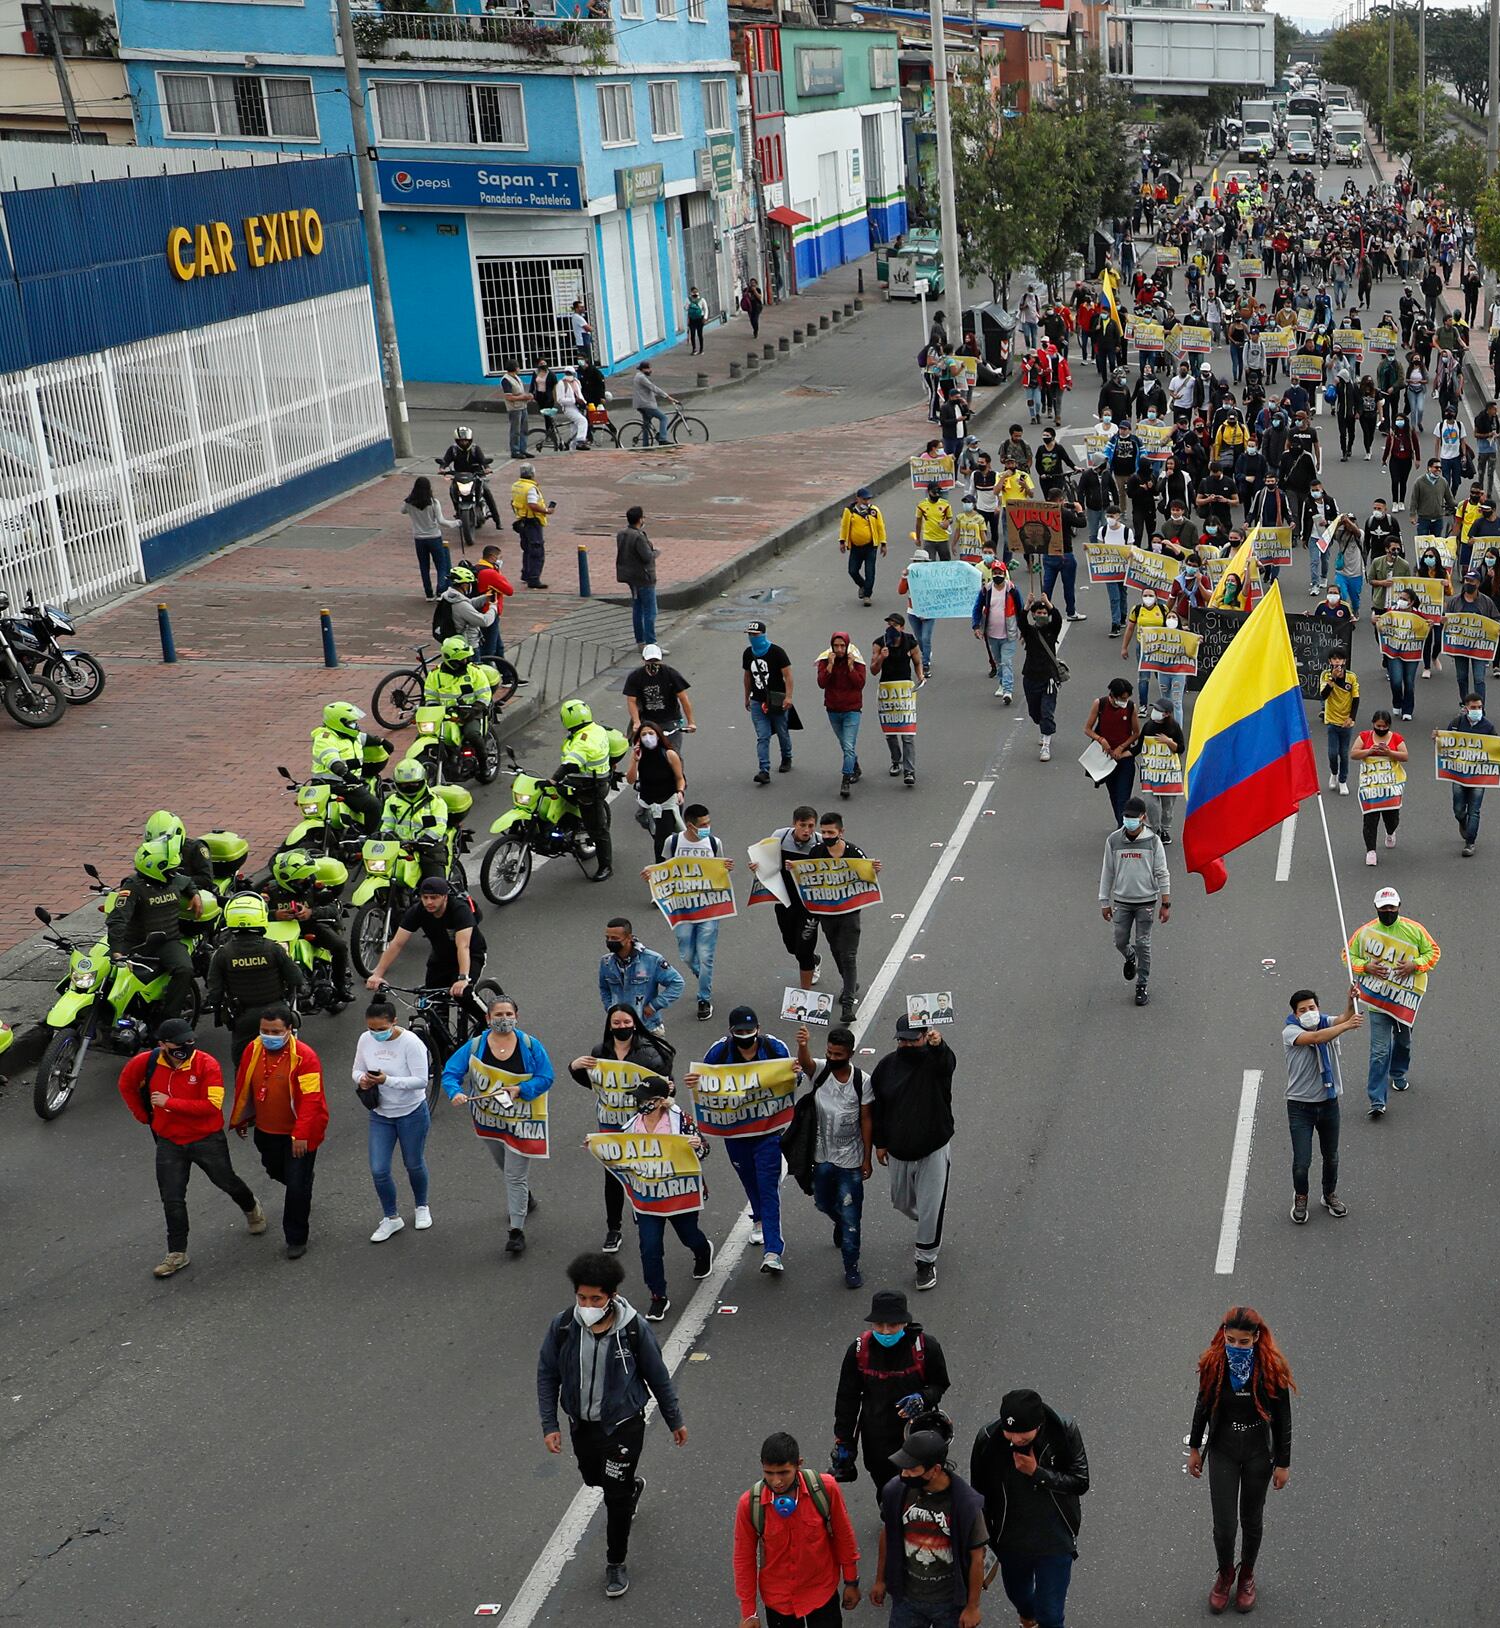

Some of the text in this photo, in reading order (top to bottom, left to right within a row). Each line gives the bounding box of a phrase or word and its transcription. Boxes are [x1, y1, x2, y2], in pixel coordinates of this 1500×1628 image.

[416, 176, 451, 191] pepsi
[478, 170, 534, 191] Sapan
[480, 191, 571, 207] Panadería Pastelería
[168, 207, 324, 281] CAR EXITO
[1447, 614, 1483, 628] NO A LA
[1446, 625, 1486, 639] REFORMA
[1446, 634, 1495, 651] TRIBUTARIA
[1441, 736, 1483, 749] NO A LA
[1440, 749, 1489, 762] REFORMA
[1440, 758, 1500, 775] TRIBUTARIA
[652, 863, 703, 883] NO A LA
[799, 859, 848, 873] NO A LA
[801, 871, 859, 886] REFORMA
[656, 880, 712, 899] REFORMA
[803, 881, 878, 901] TRIBUTARIA
[150, 892, 178, 906] POLICIA
[1365, 938, 1396, 962] NO A
[231, 956, 268, 968] POLICIA
[1359, 976, 1420, 1011] TRIBUTARIA
[475, 1070, 489, 1091] NO
[605, 1071, 643, 1089] A LA
[699, 1073, 760, 1093] NO A LA
[699, 1087, 774, 1110] REFORMA
[699, 1095, 794, 1125] TRIBUTARIA
[472, 1107, 545, 1140] TRIBUTARIA
[597, 1139, 662, 1161] NO A LA
